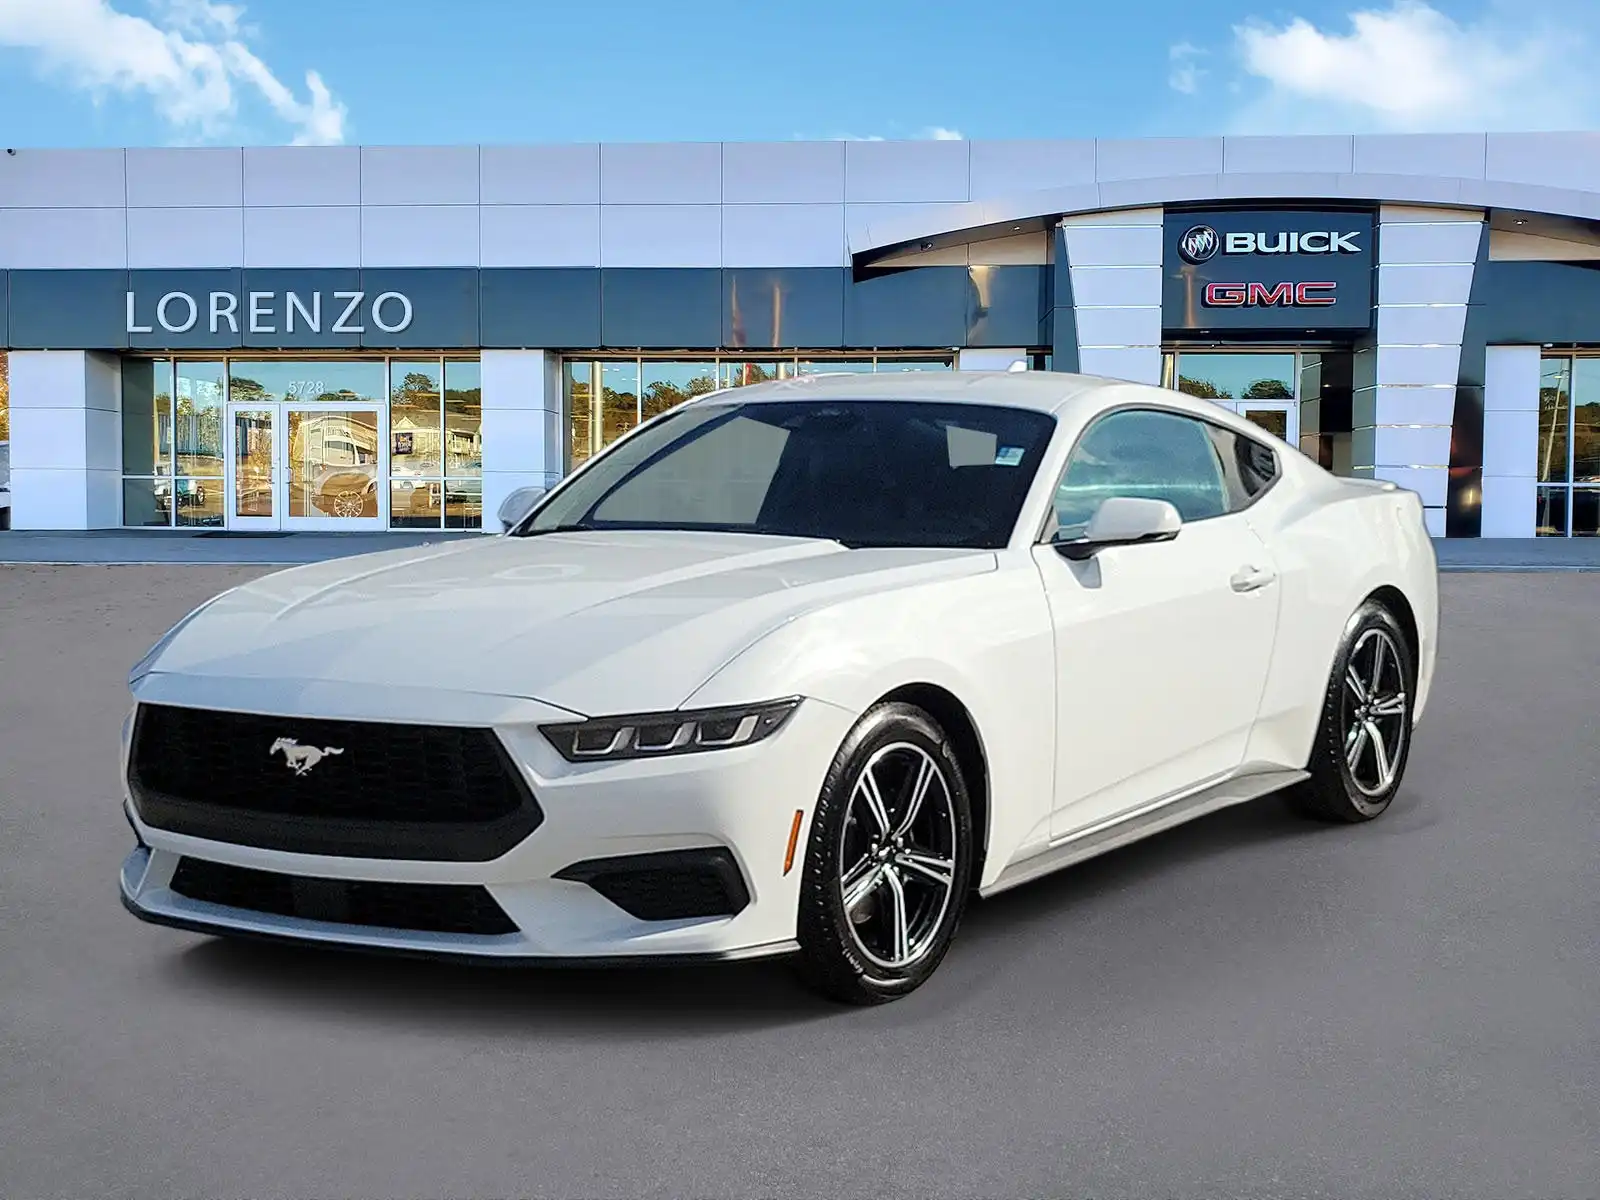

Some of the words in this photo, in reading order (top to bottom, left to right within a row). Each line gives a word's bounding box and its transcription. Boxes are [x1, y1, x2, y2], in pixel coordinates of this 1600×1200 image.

[1225, 231, 1362, 253] BUICK
[1205, 281, 1337, 305] GMC
[126, 291, 413, 333] LORENZO
[288, 380, 324, 395] 5728
